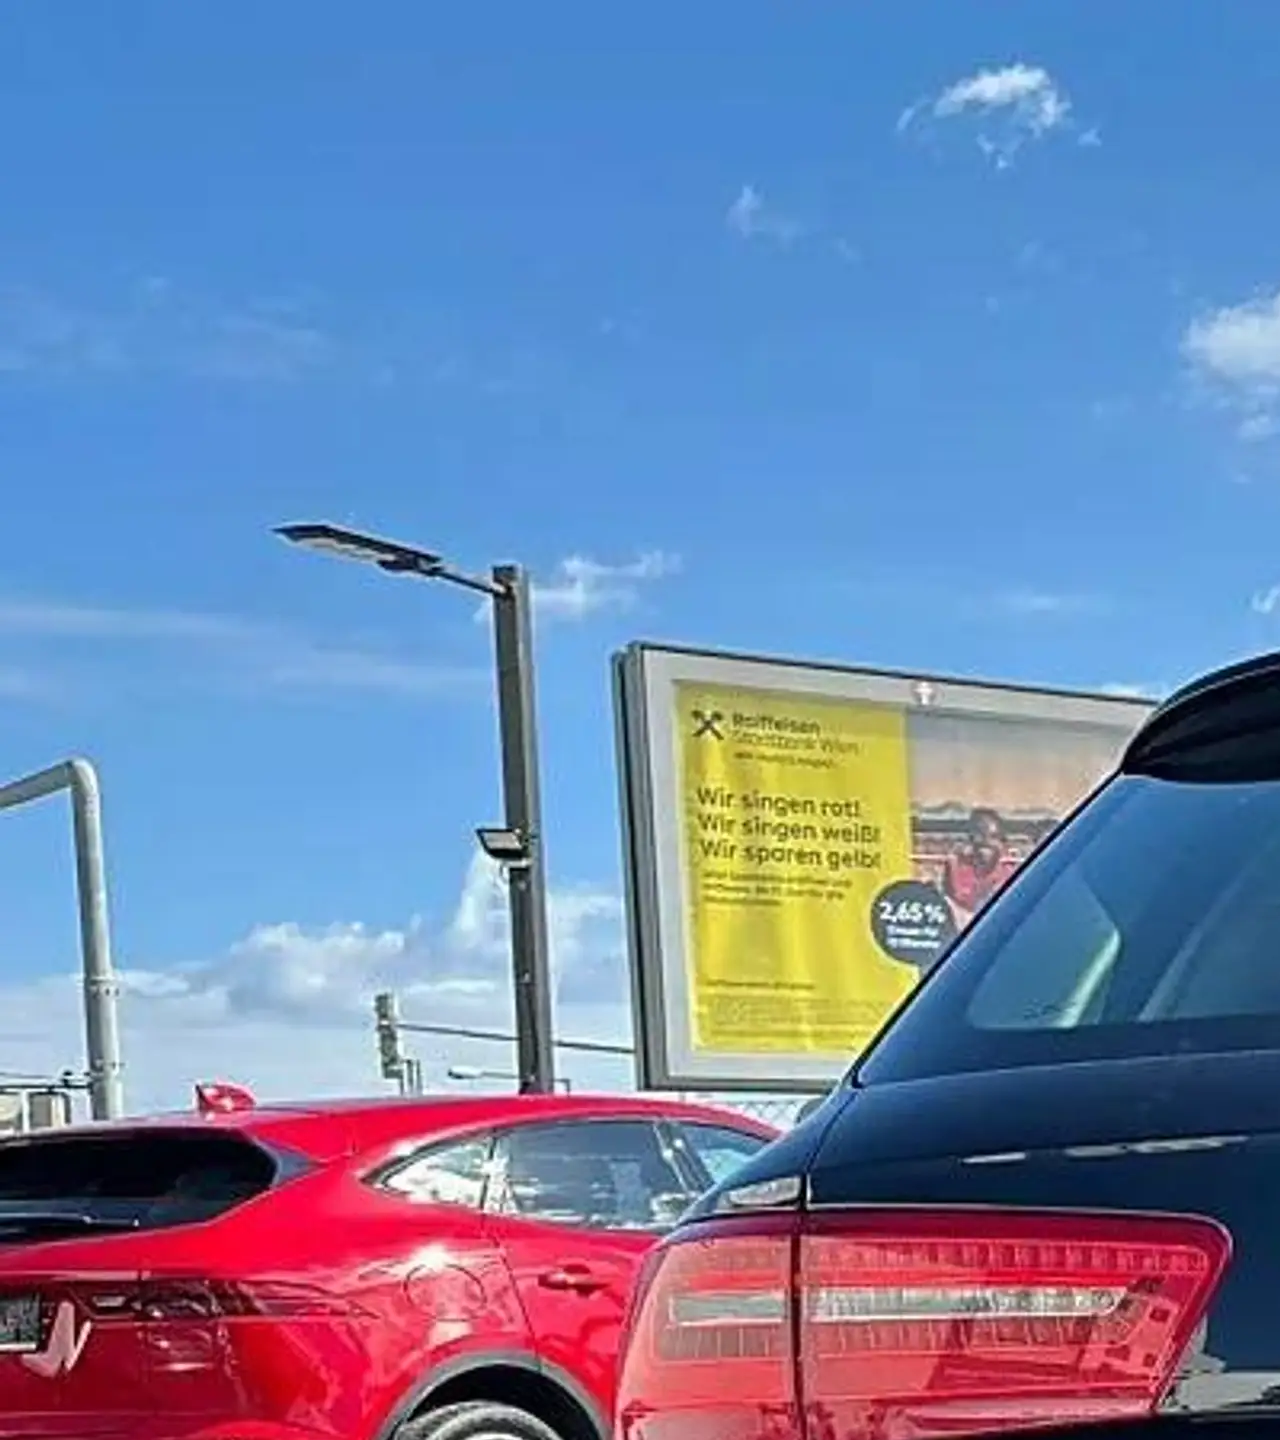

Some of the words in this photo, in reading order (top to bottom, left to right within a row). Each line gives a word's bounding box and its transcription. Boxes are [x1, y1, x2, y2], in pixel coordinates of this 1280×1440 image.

[697, 787, 735, 808] Wir
[742, 790, 815, 817] singen
[821, 798, 861, 818] rot!
[698, 813, 737, 833] Wir
[741, 816, 820, 842] singen
[700, 839, 737, 860] Wir
[743, 844, 822, 866] sparen
[826, 850, 881, 871] gelb!
